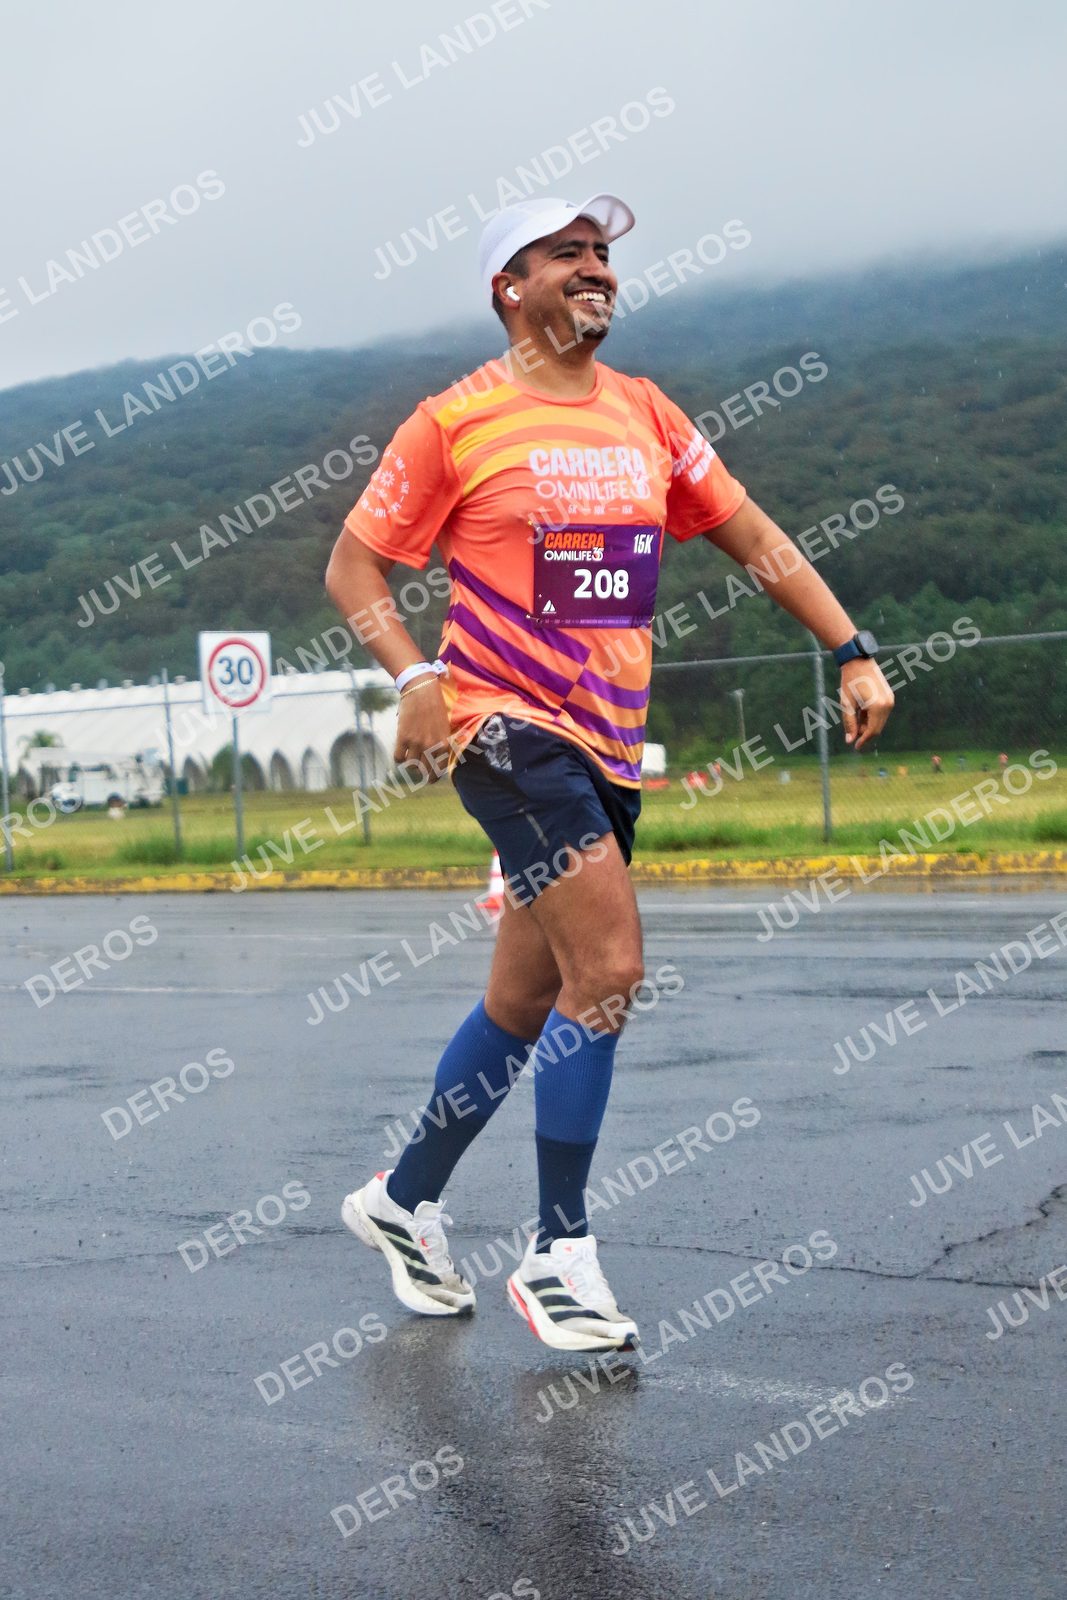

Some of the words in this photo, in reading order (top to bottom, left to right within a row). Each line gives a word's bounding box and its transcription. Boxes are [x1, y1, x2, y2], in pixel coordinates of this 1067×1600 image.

[529, 446, 647, 478] CARRERA
[544, 532, 605, 550] CARRERA
[544, 550, 592, 562] OMNILIFE
[573, 569, 630, 599] 208
[218, 655, 254, 686] 30
